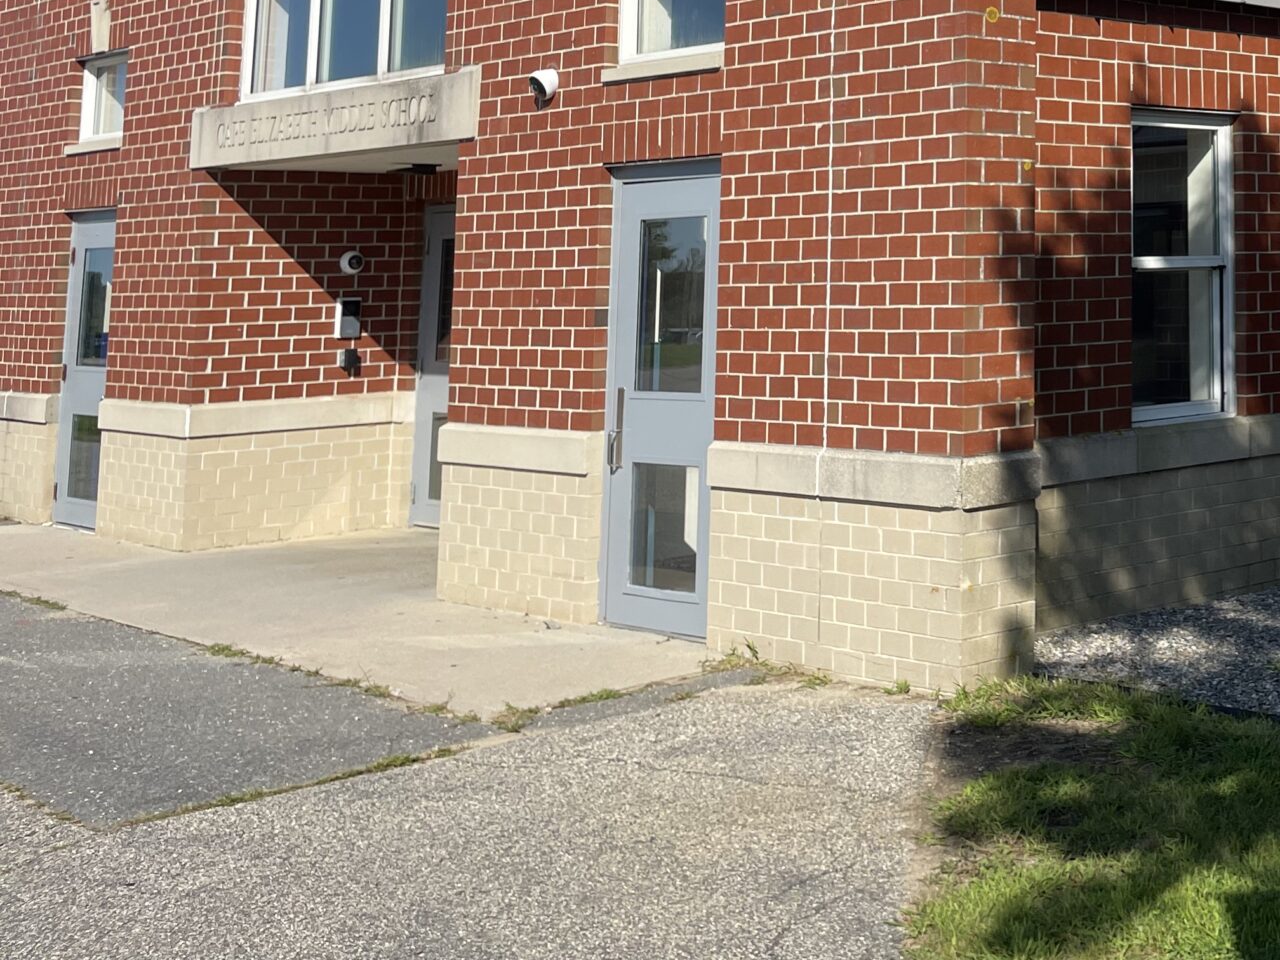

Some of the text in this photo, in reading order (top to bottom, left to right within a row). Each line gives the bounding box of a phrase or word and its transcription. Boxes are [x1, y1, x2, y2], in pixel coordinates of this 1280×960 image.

[216, 120, 246, 149] CAPE
[321, 102, 376, 136] MIDDLE
[381, 93, 437, 129] SCHOOL
